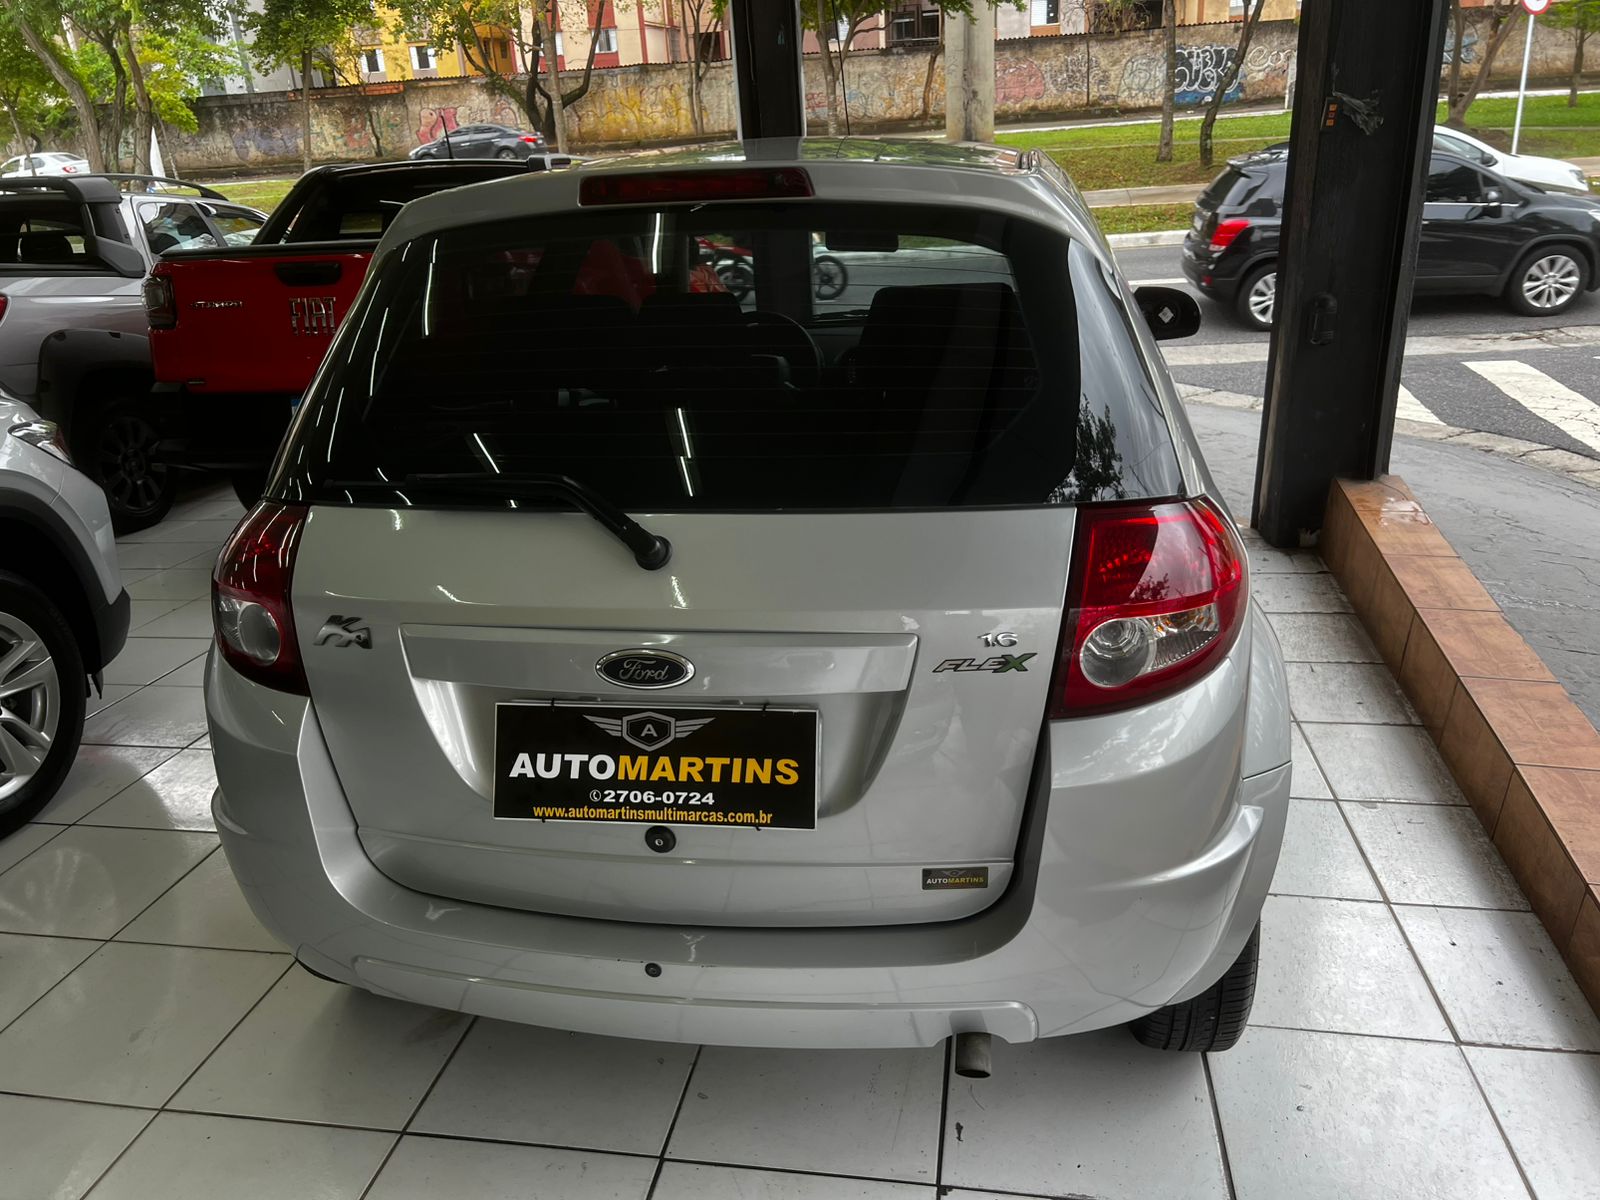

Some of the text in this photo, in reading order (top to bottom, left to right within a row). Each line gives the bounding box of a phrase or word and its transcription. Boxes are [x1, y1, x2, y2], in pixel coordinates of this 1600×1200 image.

[289, 297, 336, 335] FIAT
[618, 659, 669, 681] Ford
[932, 652, 1038, 673] FLEX
[640, 723, 658, 737] A
[509, 753, 800, 785] AUTOMARTINS
[603, 789, 715, 805] 2706-0724
[533, 805, 773, 825] www.automartinsmultimarcas.com.br
[926, 876, 984, 885] AUTOMARTINS
